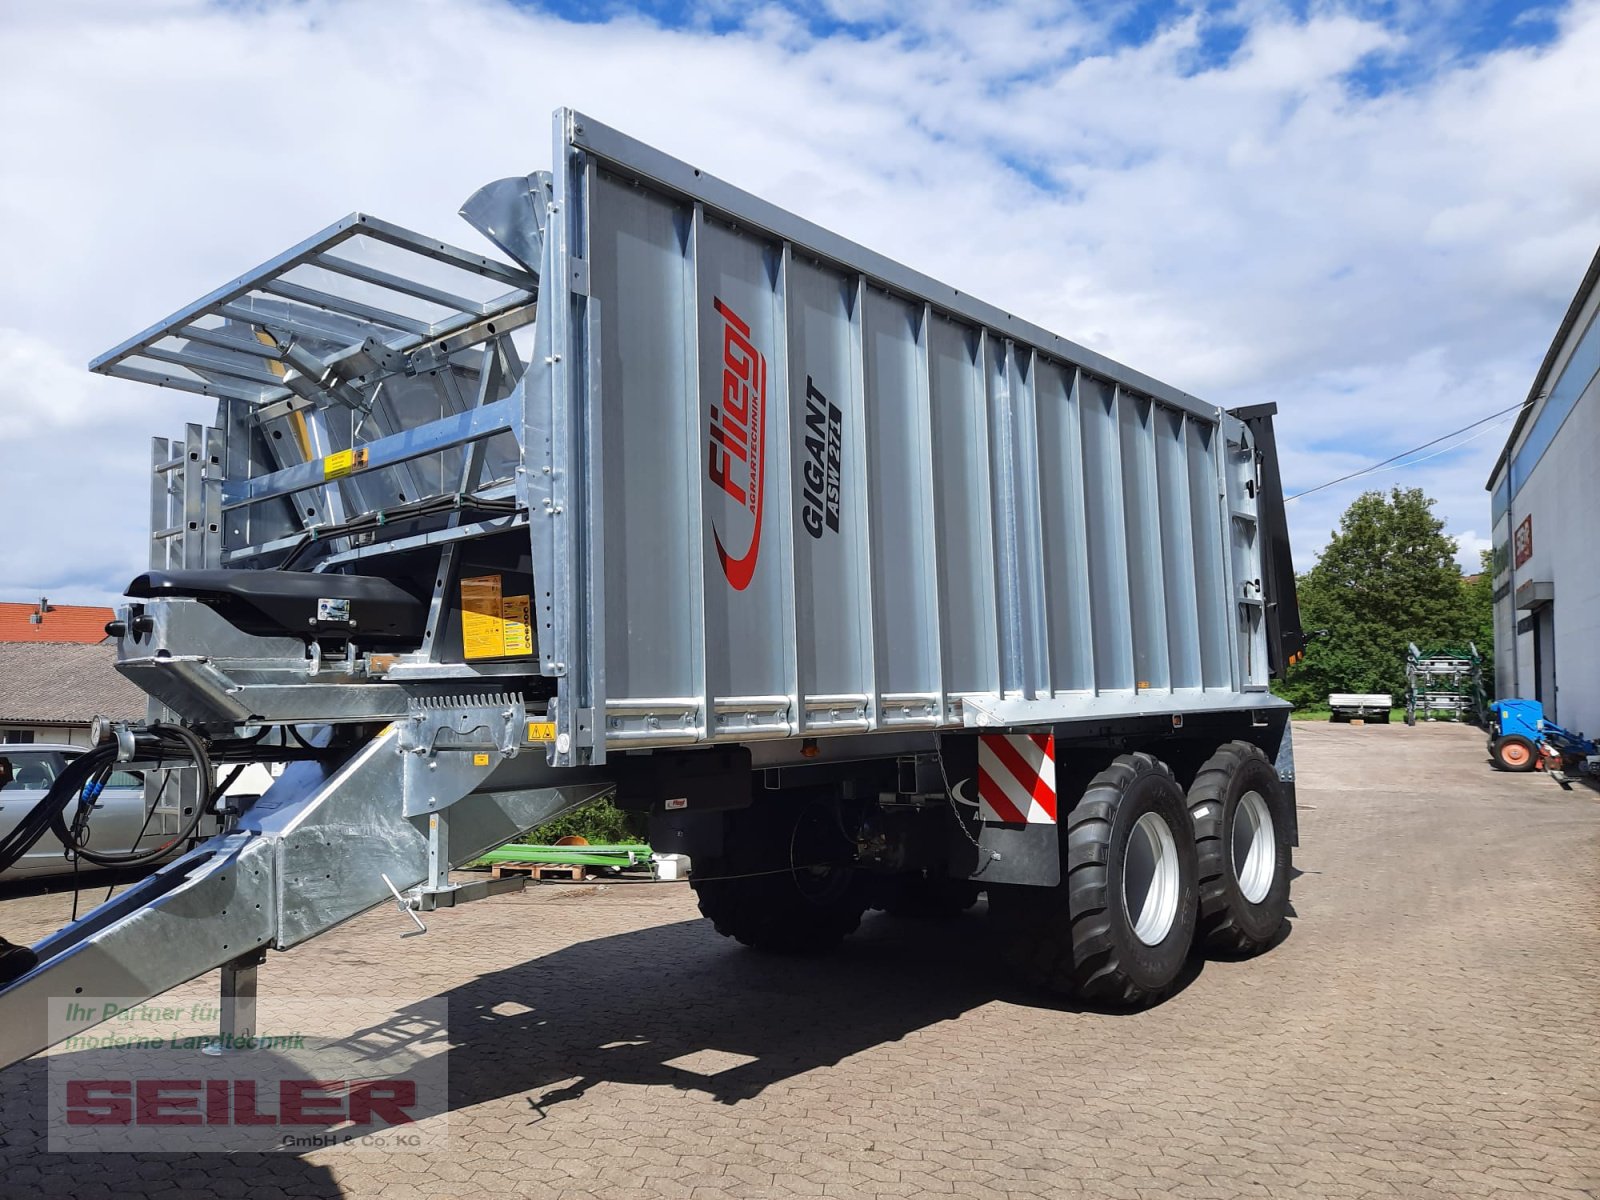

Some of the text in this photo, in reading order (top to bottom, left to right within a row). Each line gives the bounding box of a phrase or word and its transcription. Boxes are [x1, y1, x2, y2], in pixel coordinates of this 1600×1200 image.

[709, 296, 758, 506] Fliegl
[749, 393, 759, 516] AGRARTECHNIK
[802, 374, 827, 539] GIGANT
[827, 418, 841, 519] ASW 271
